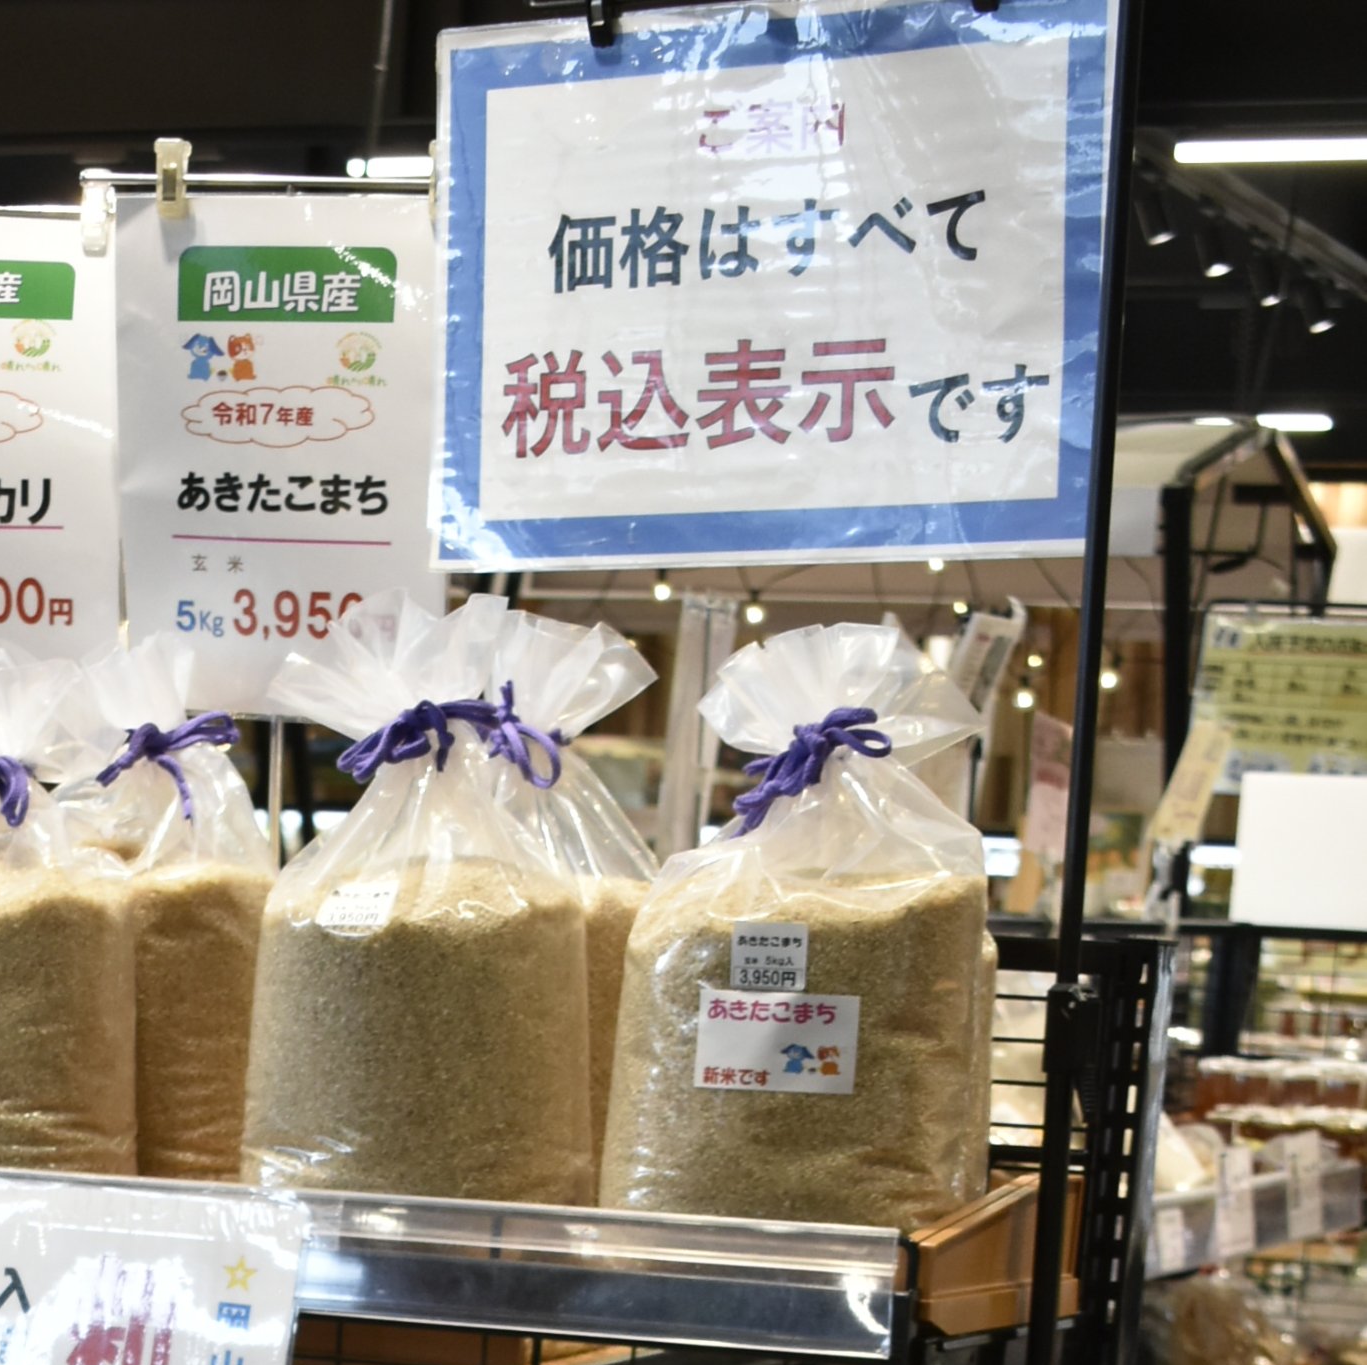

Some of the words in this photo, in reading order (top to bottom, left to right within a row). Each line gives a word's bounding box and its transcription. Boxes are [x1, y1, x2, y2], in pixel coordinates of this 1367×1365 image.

[547, 189, 987, 293] 価格はすべて
[202, 269, 361, 313] 岡山県産
[211, 402, 315, 427] 令和7年産
[501, 337, 1051, 460] 税込表示です
[177, 471, 388, 517] あきたこまち
[175, 600, 225, 638] 5Kg
[737, 935, 803, 949] あきたこまち
[739, 969, 797, 988] 3,950円
[707, 998, 838, 1025] あきたこまち
[702, 1066, 772, 1088] 新米です
